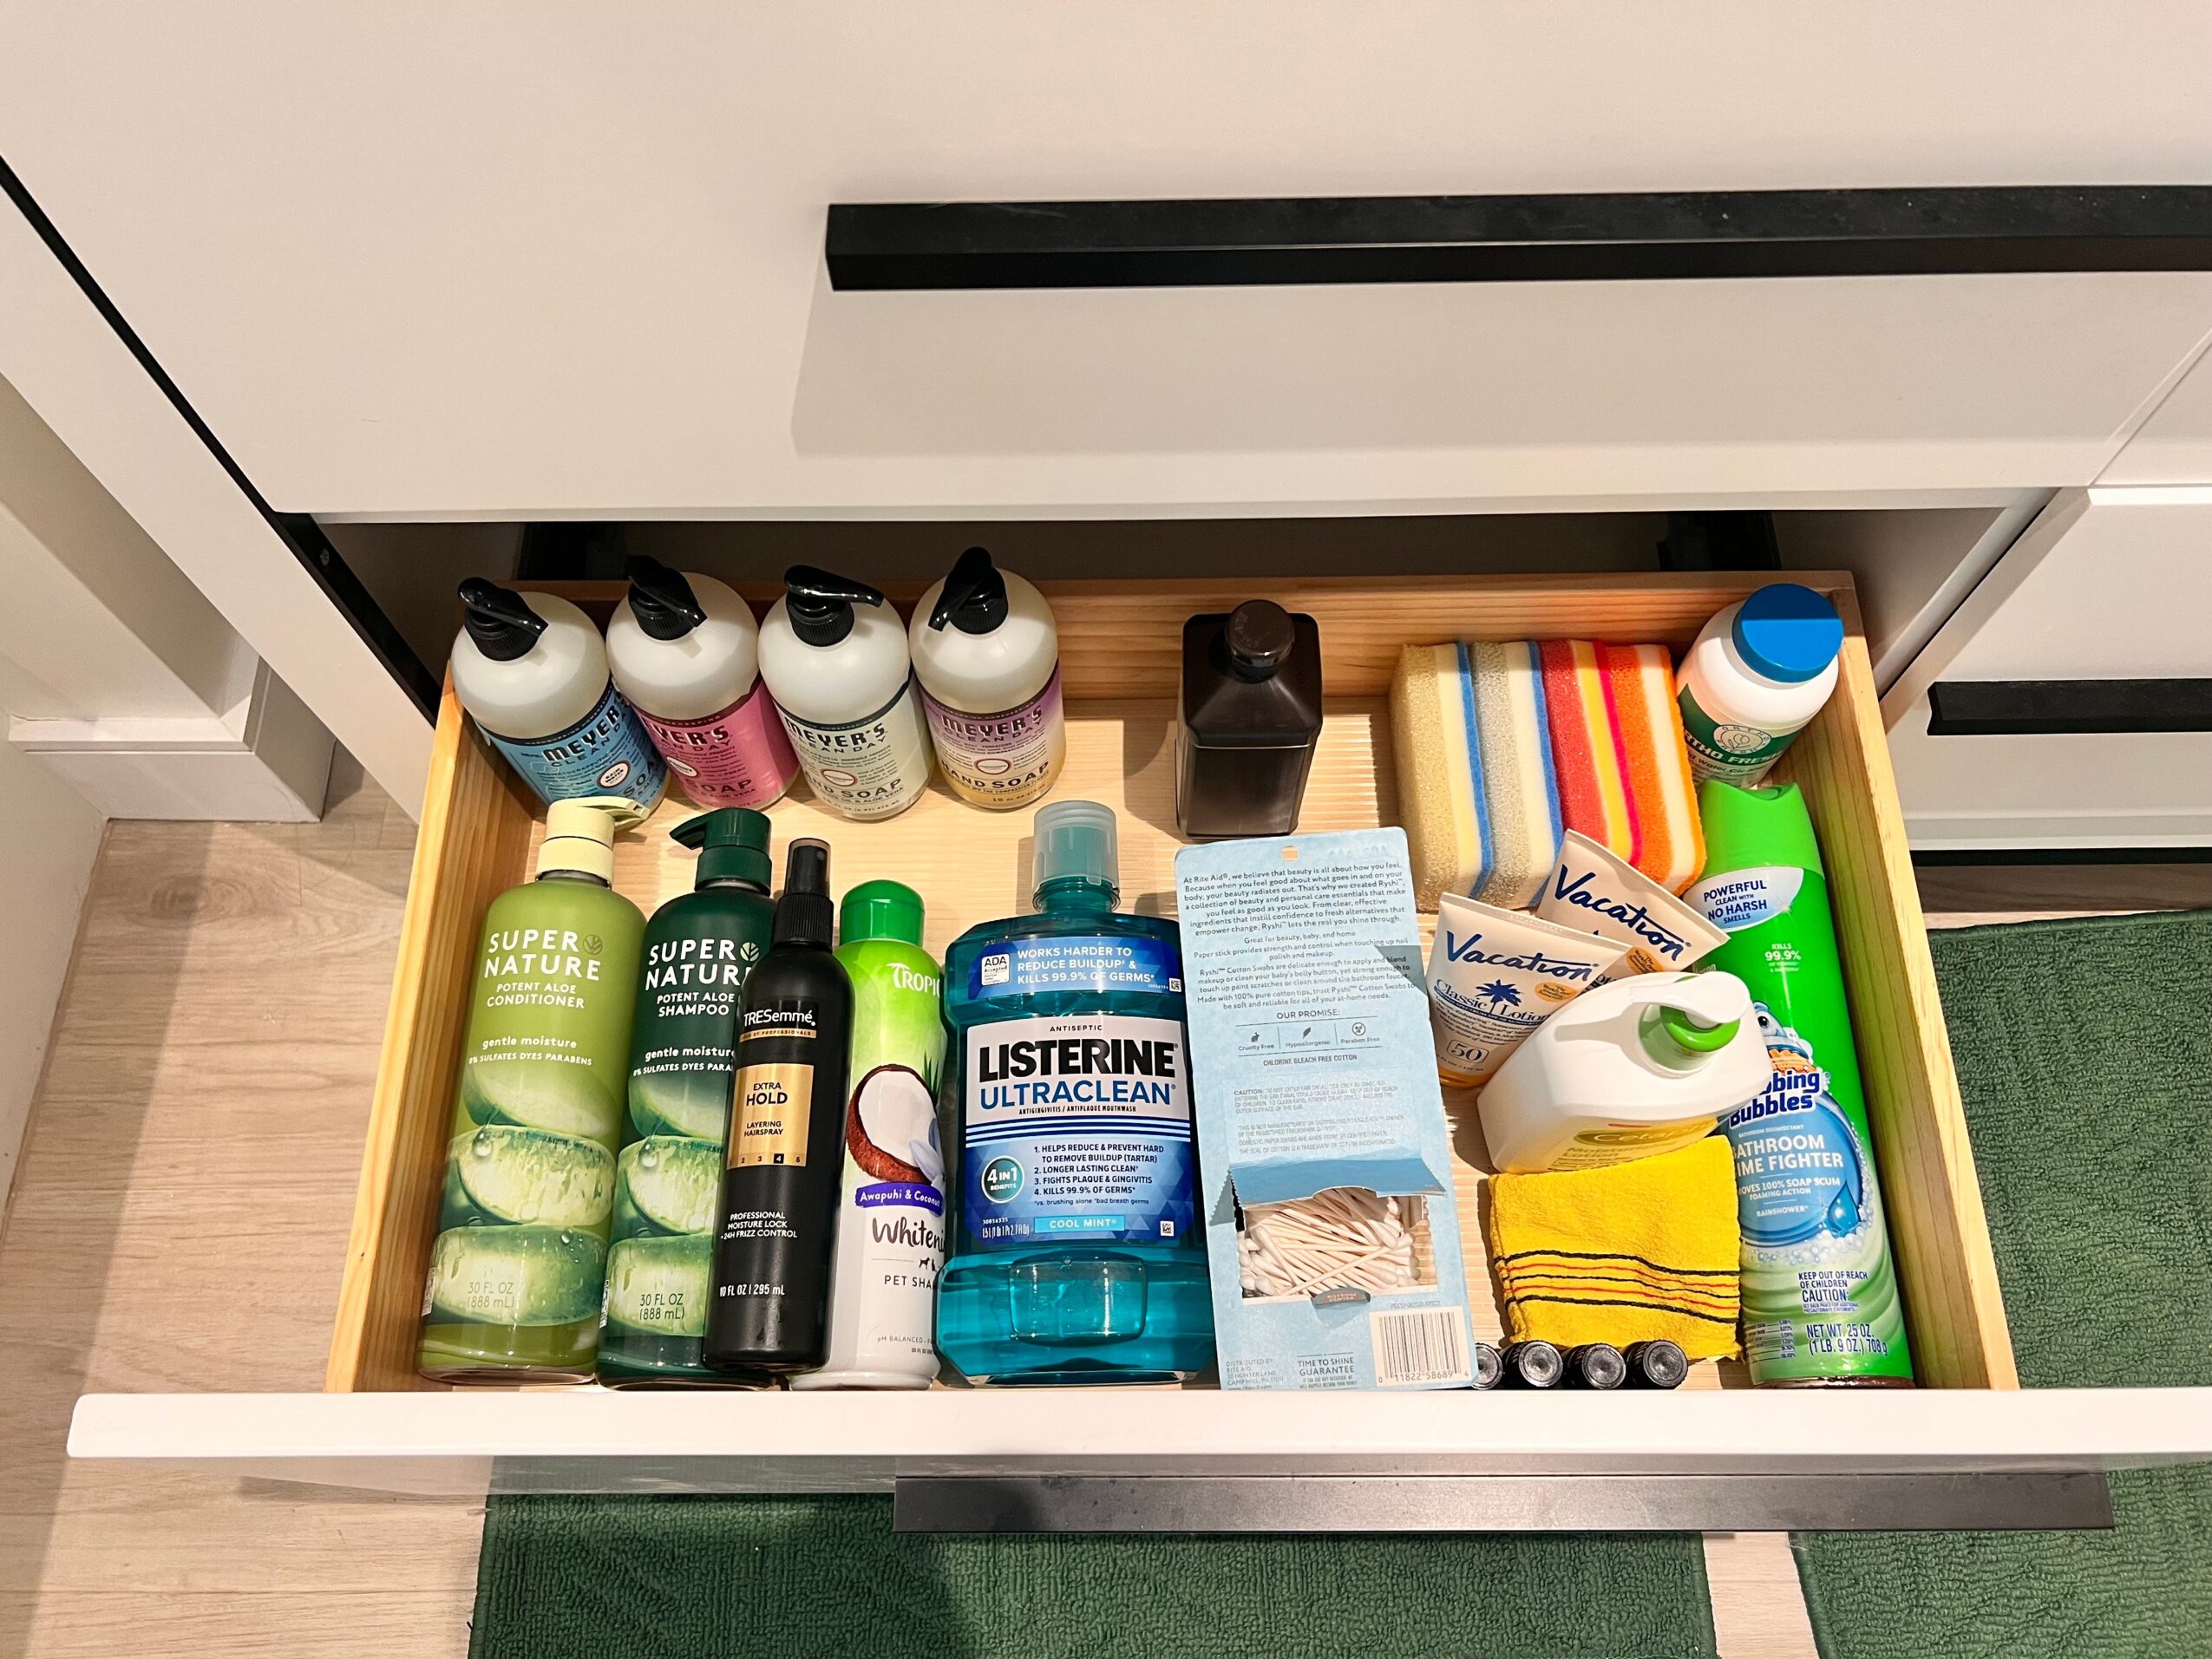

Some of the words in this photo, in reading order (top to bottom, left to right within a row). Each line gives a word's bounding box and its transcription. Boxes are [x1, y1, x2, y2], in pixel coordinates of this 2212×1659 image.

[941, 705, 1041, 737] MEYER'S
[785, 717, 886, 747] MEYER'S
[945, 728, 1004, 742] CLEAN
[1012, 720, 1041, 738] DAY
[854, 735, 886, 752] DAY
[941, 760, 985, 787] HAND
[991, 761, 1048, 787] SOAP
[841, 779, 900, 798] SOAP
[1704, 879, 1767, 902] POWERFUL
[1715, 895, 1737, 905] CLEAN
[1555, 864, 1685, 961] Vacation
[1708, 908, 1724, 921] NO
[1726, 899, 1767, 916] HARSH
[1724, 913, 1751, 924] SMELLS
[488, 929, 579, 953] SUPER
[649, 939, 736, 965] SUPER
[1018, 948, 1060, 959] WORKS
[1063, 947, 1113, 957] HARDER
[1116, 948, 1131, 957] TO
[1446, 931, 1594, 981] Vacation
[1765, 950, 1801, 961] 99.9%
[485, 954, 600, 981] NATURE
[985, 957, 1007, 967] ADA
[1018, 961, 1065, 971] REDUCE
[1018, 974, 1048, 984] KILLS
[1052, 972, 1087, 981] 99.9%
[1090, 972, 1105, 981] OF
[496, 983, 540, 992] POTENT
[544, 983, 576, 994] ALOE
[1435, 979, 1487, 1011] Classic
[488, 994, 584, 1009] CONDITIONER
[657, 992, 699, 1004] POTENT
[703, 993, 735, 1002] ALOE
[658, 1004, 729, 1017] SHAMPOO
[1299, 1009, 1340, 1018] PROMISE:
[482, 1036, 517, 1050] gentle
[521, 1035, 577, 1048] moisture
[645, 1047, 678, 1061] gentle
[1451, 1043, 1482, 1061] 50
[480, 1053, 517, 1062] SULFATES
[546, 1054, 592, 1065] PARABENS
[1264, 1057, 1292, 1066] CHLORINE
[1293, 1055, 1317, 1064] BLEACH
[643, 1064, 679, 1074] SULFATES
[746, 1092, 788, 1106] HOLD
[1124, 1154, 1157, 1163] (TARTAR)
[1769, 1153, 1843, 1171] FIGHTER
[987, 1168, 997, 1183] 4
[999, 1171, 1010, 1180] IN
[1011, 1167, 1017, 1180] 1
[1763, 1180, 1784, 1190] 100%
[861, 1189, 901, 1203] Awapuhi
[905, 1189, 912, 1199] &
[914, 1191, 939, 1206] Coconut
[1750, 1190, 1780, 1200] FOAMING
[1783, 1187, 1810, 1196] ACTION
[730, 1212, 785, 1221] PROFESSIONAL
[728, 1221, 762, 1230] MOISTURE
[1050, 1219, 1079, 1229] COOL
[885, 1275, 907, 1286] PET
[1798, 1271, 1816, 1280] KEEP
[720, 1286, 726, 1297] 10
[728, 1285, 735, 1296] FL
[737, 1284, 747, 1295] OZ
[754, 1284, 769, 1295] 295
[773, 1284, 785, 1295] mL
[1800, 1280, 1810, 1289] OF
[640, 1294, 651, 1306] 30
[655, 1294, 664, 1305] FL
[669, 1293, 684, 1305] OZ
[1803, 1290, 1849, 1302] CAUTION:
[639, 1308, 661, 1320] (888
[664, 1307, 684, 1319] mL)
[1807, 1325, 1824, 1338] NET
[1828, 1325, 1842, 1338] WT.
[1847, 1325, 1858, 1336] 25
[1861, 1325, 1874, 1337] OZ.
[1299, 1365, 1354, 1376] GUARANTEE
[1395, 1373, 1422, 1381] 11822
[1426, 1371, 1454, 1380] 58689
